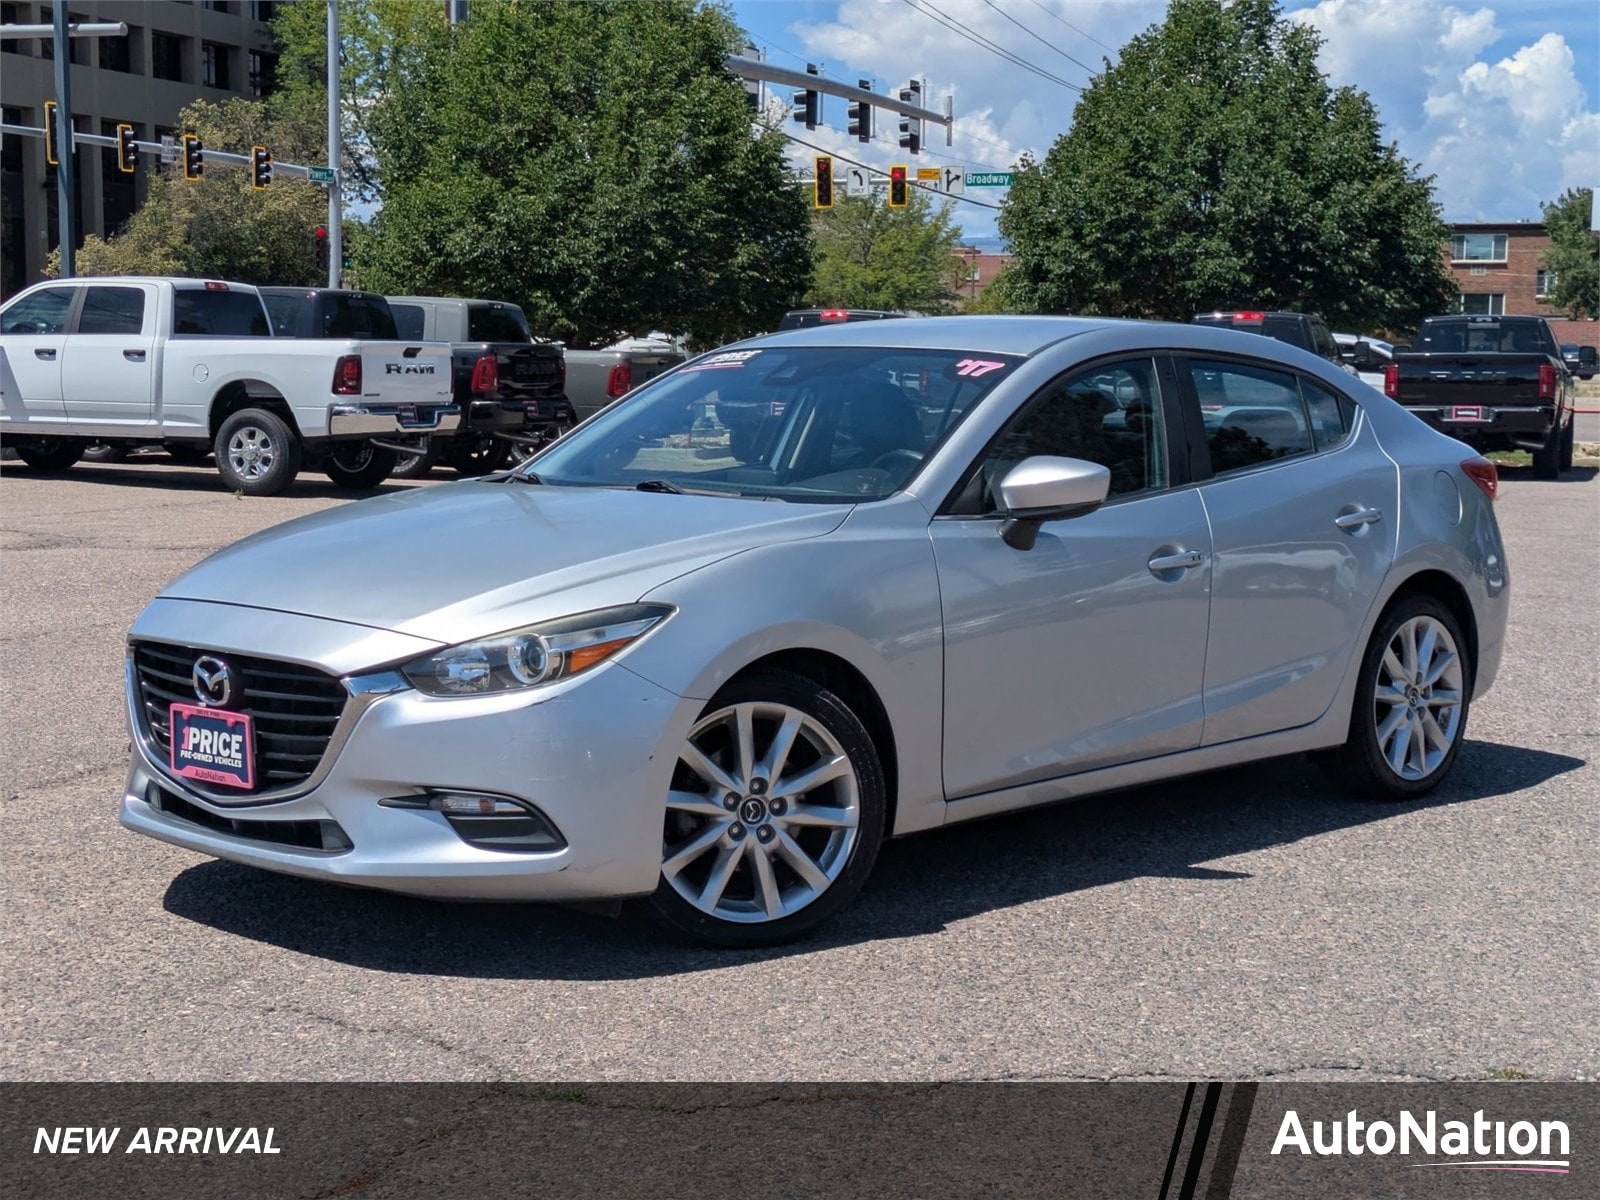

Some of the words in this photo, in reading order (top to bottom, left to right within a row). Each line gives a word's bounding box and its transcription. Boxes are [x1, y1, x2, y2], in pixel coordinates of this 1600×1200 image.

[966, 173, 1009, 186] Broadway
[386, 364, 435, 374] RAM
[180, 750, 213, 763] PRE-OWNED
[214, 756, 242, 768] VEHICLES
[195, 769, 226, 782] AutoNation
